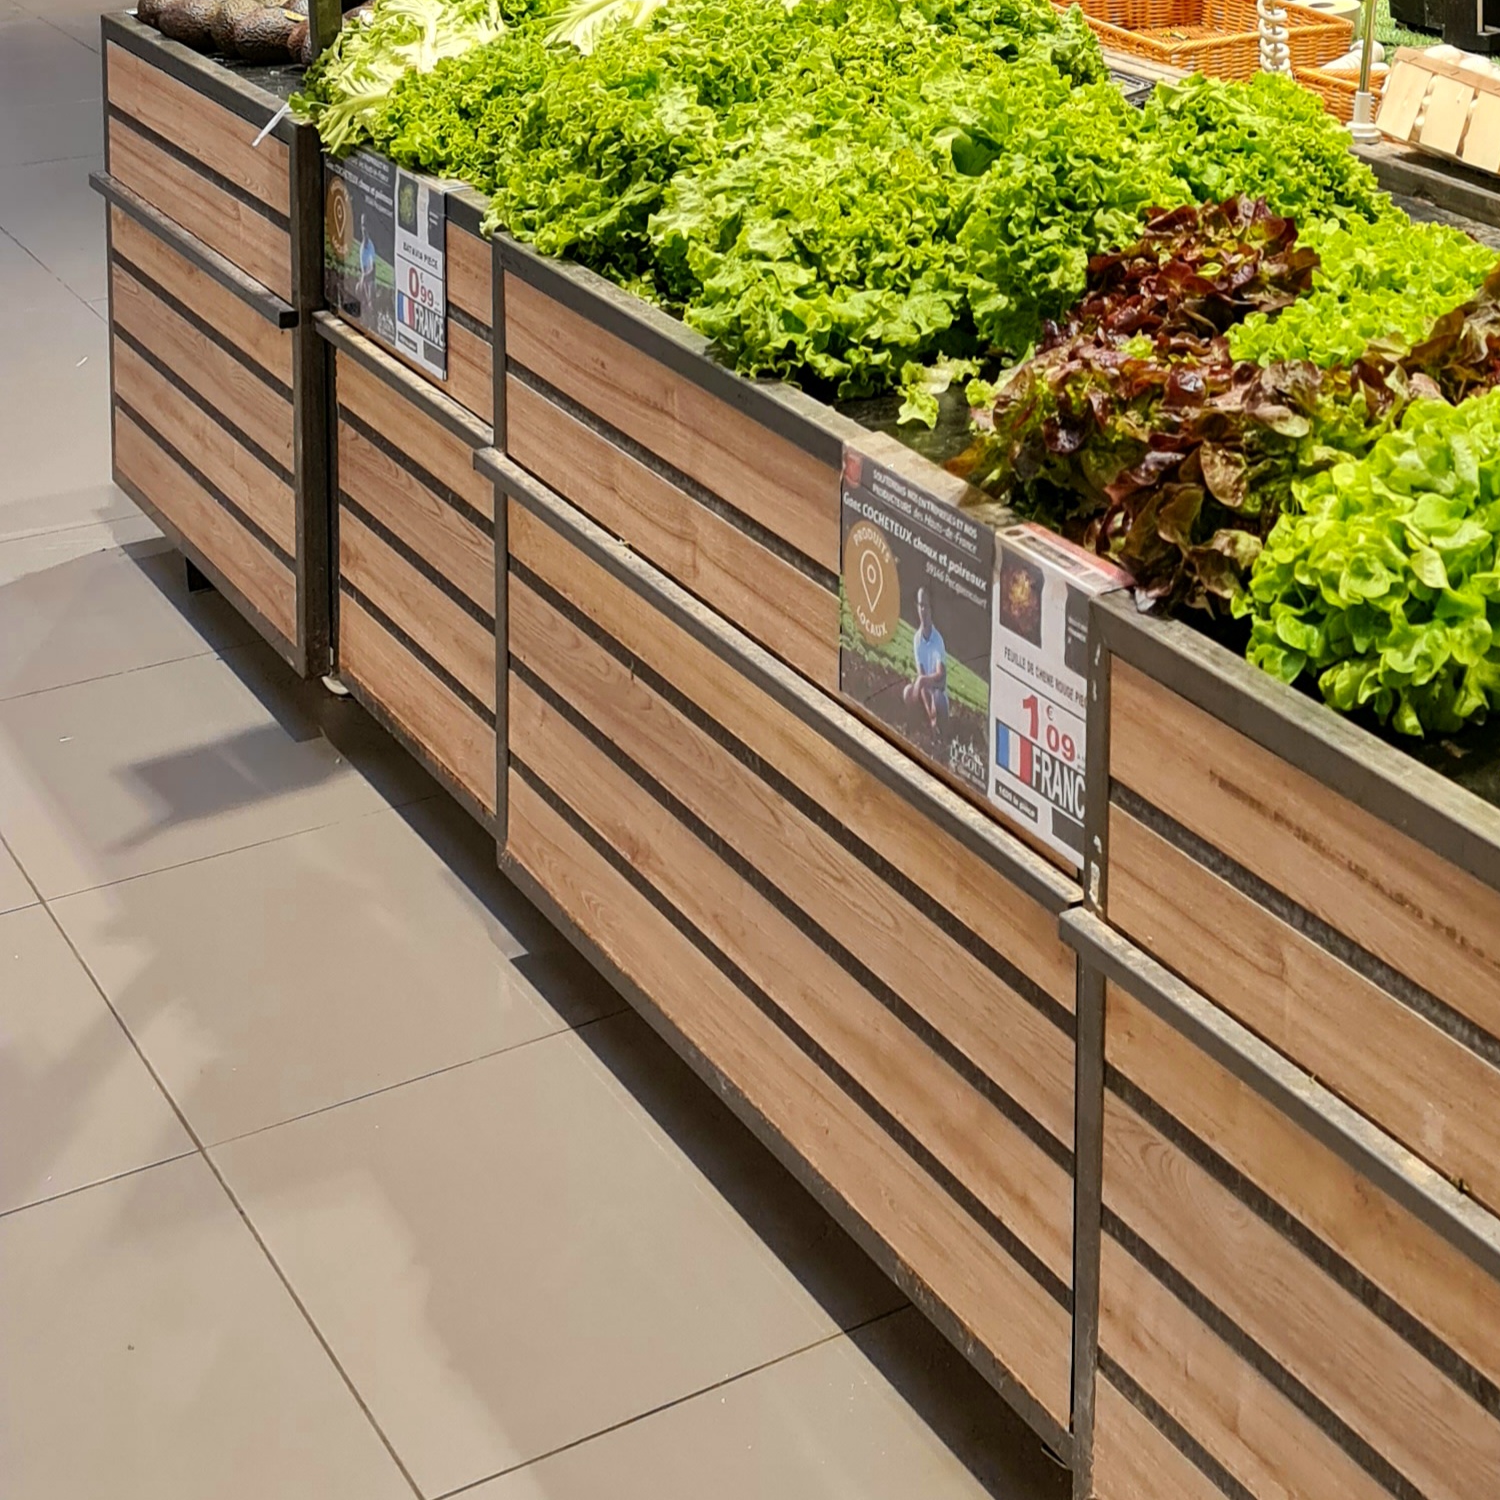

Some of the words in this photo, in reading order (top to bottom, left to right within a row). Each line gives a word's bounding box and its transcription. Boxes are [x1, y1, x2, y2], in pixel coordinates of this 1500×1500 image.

[409, 267, 419, 298] 0
[420, 285, 434, 308] 99
[415, 304, 444, 347] FRANCE
[853, 527, 891, 564] PRODUITS
[862, 503, 912, 546] COCHETEUX
[913, 536, 938, 563] choux
[938, 549, 948, 566] et
[948, 559, 987, 592] poireaux
[856, 605, 888, 637] LOCAUX
[1004, 645, 1026, 671] FEUILLE
[1027, 661, 1034, 677] DE
[1036, 666, 1054, 689] CHENE
[1055, 677, 1074, 700] ROUGE
[1075, 687, 1087, 709] PIE
[1022, 694, 1039, 741] 1
[1046, 724, 1075, 763] 09
[1032, 743, 1085, 820] FRANC
